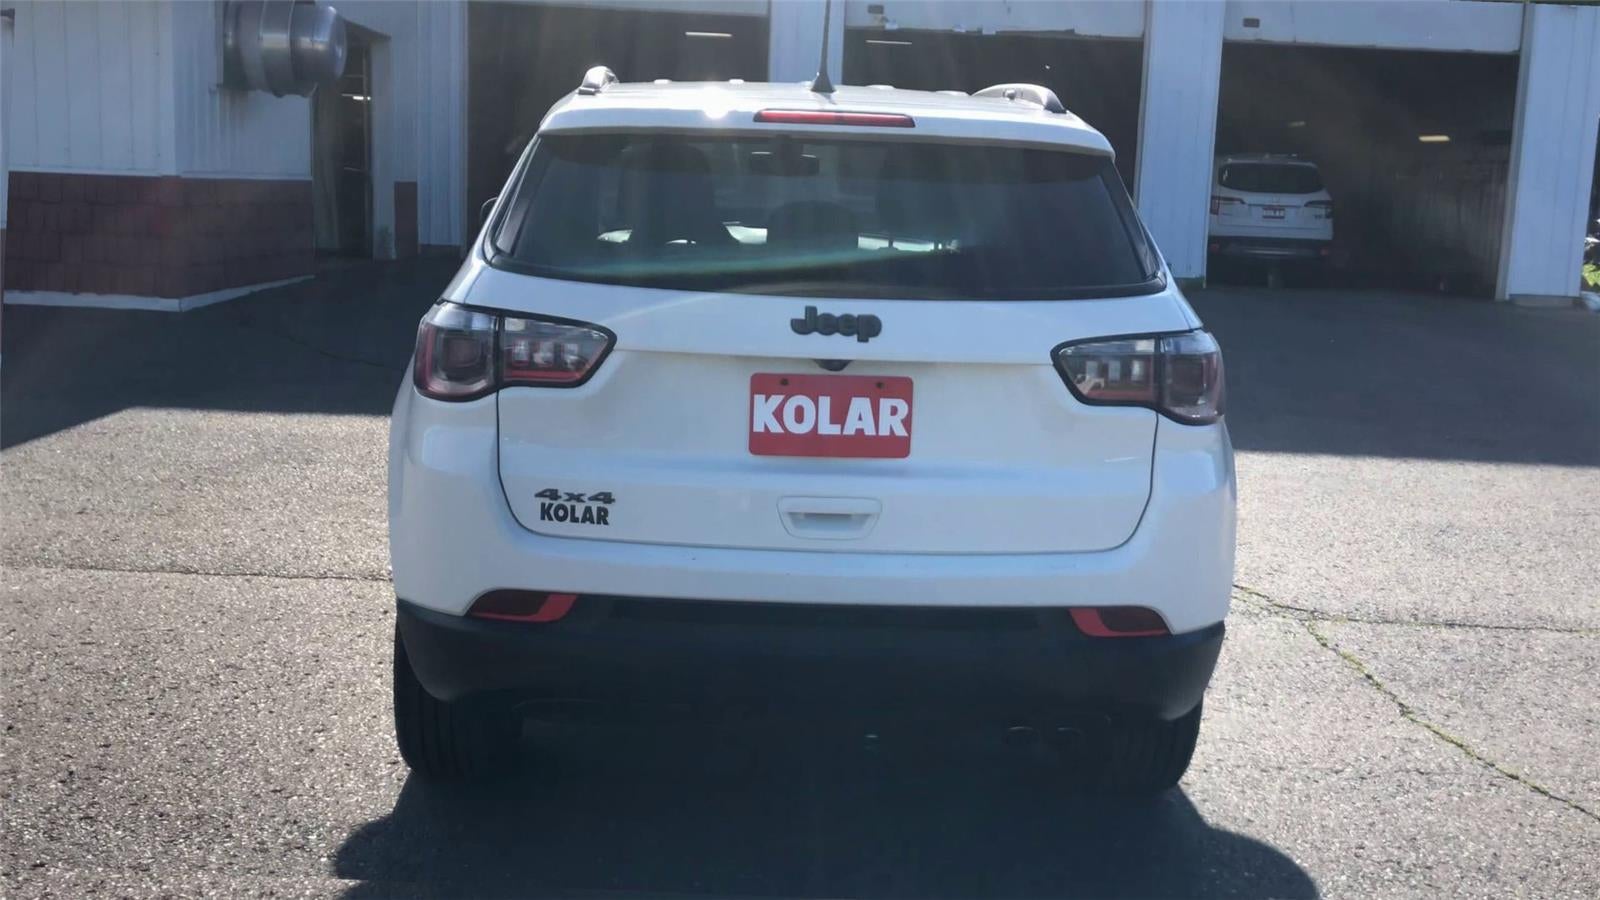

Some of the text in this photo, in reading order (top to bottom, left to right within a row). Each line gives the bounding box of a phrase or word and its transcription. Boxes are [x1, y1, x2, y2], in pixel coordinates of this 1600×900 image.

[791, 306, 882, 343] Jeep
[752, 394, 909, 437] KOLAR
[534, 489, 615, 504] 4x4
[540, 502, 609, 525] KOLAR
